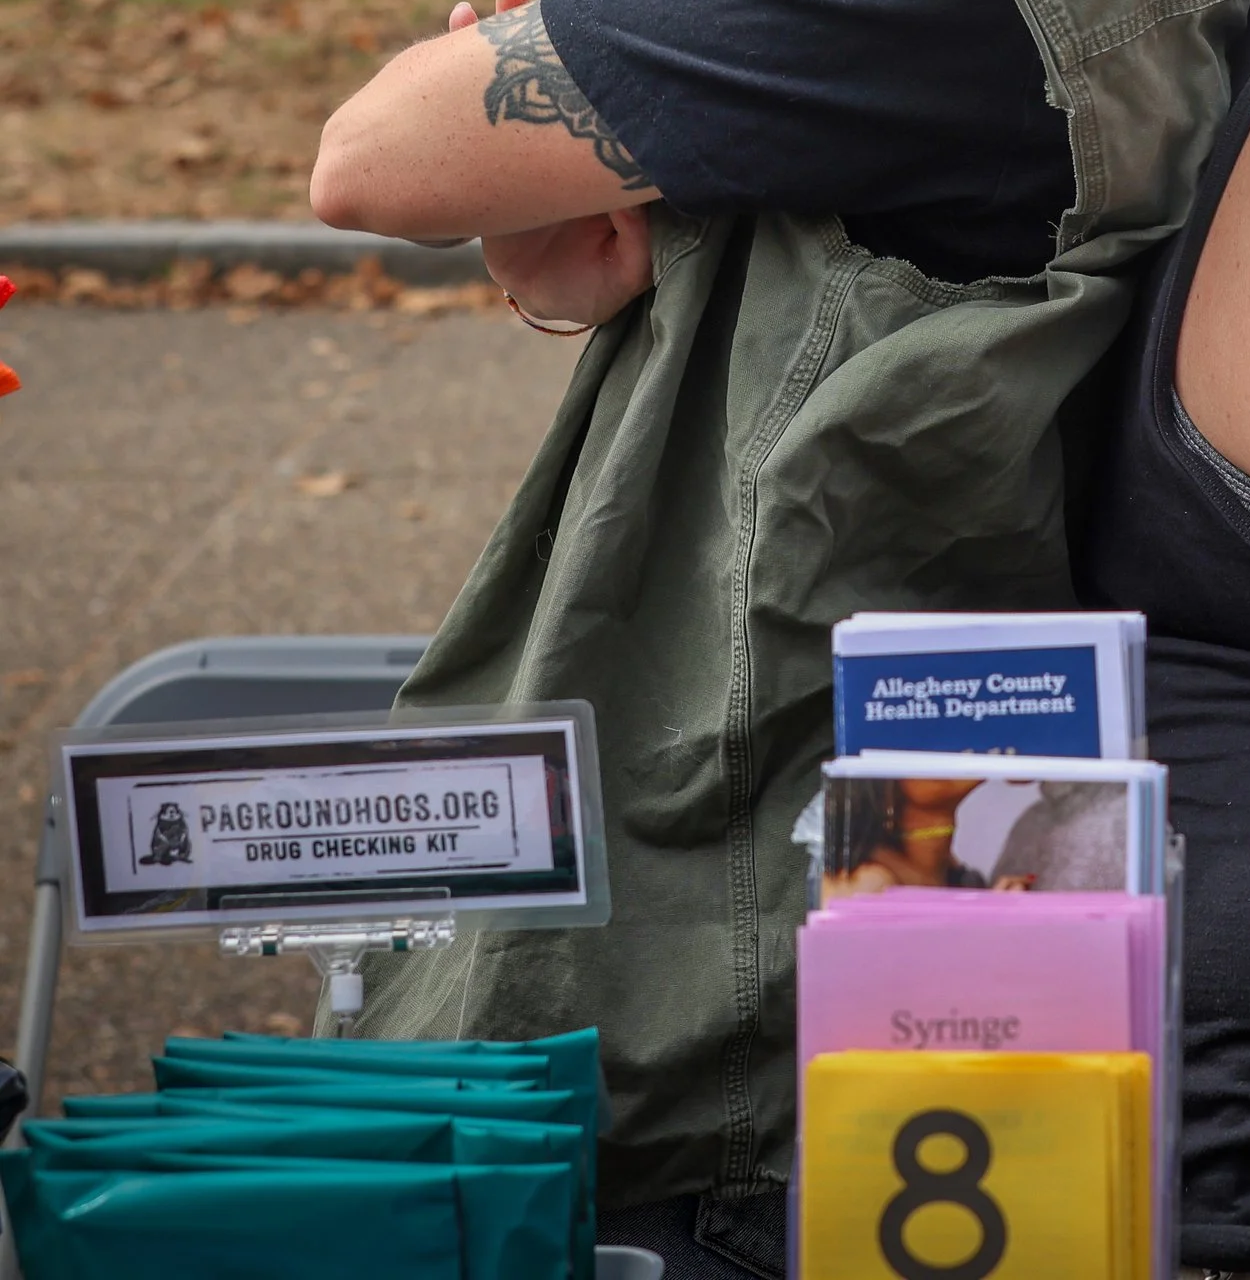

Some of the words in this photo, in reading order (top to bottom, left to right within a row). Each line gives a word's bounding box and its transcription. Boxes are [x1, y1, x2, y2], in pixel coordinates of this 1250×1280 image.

[872, 675, 982, 699] Allegheny
[986, 672, 1067, 695] County
[864, 699, 940, 721] Health
[944, 694, 1076, 721] Department
[199, 790, 500, 834] PAGROUNDHOGS.ORG
[245, 837, 302, 862] DRUG
[312, 834, 416, 859] CHECKING
[426, 833, 460, 854] KIT
[890, 1008, 1021, 1050] Syringe
[877, 1106, 1008, 1280] 8
